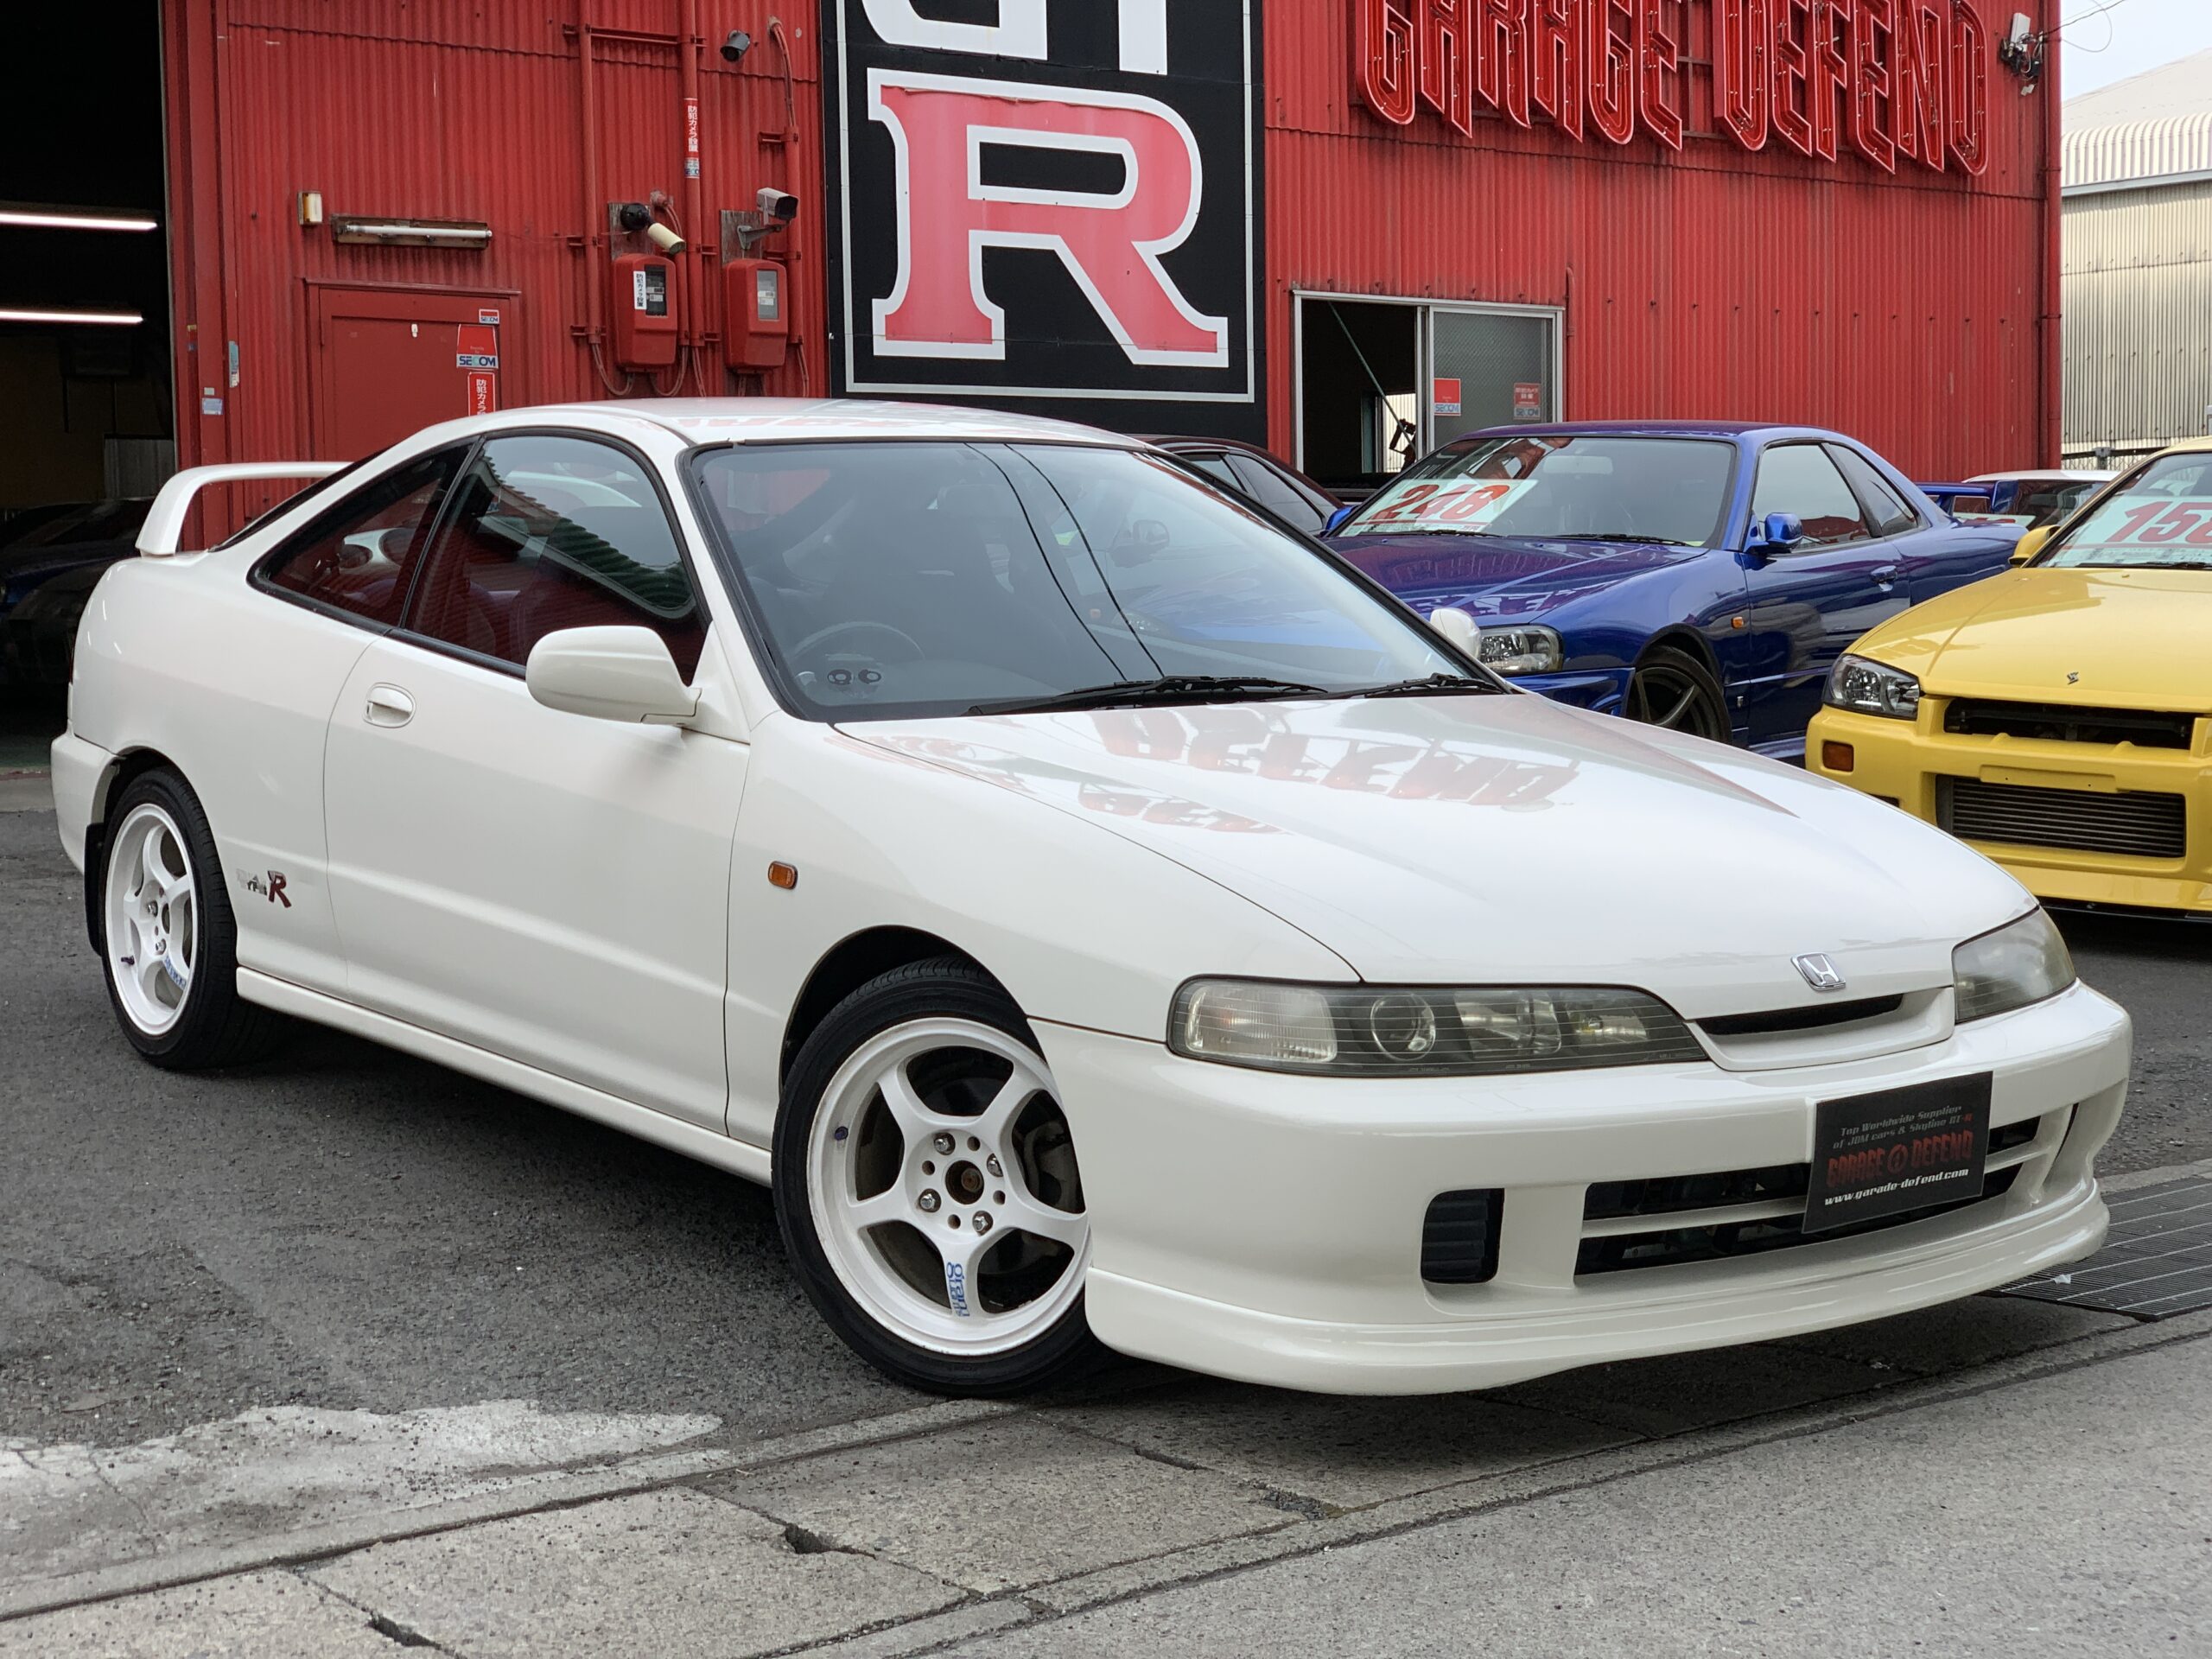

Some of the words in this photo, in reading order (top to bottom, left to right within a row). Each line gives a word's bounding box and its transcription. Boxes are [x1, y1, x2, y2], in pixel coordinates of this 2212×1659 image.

[1362, 0, 1682, 151] GARAGE
[1719, 0, 1989, 175] DEFEND
[867, 67, 1229, 368] R
[459, 355, 496, 366] SECOM
[1370, 484, 1510, 520] 248
